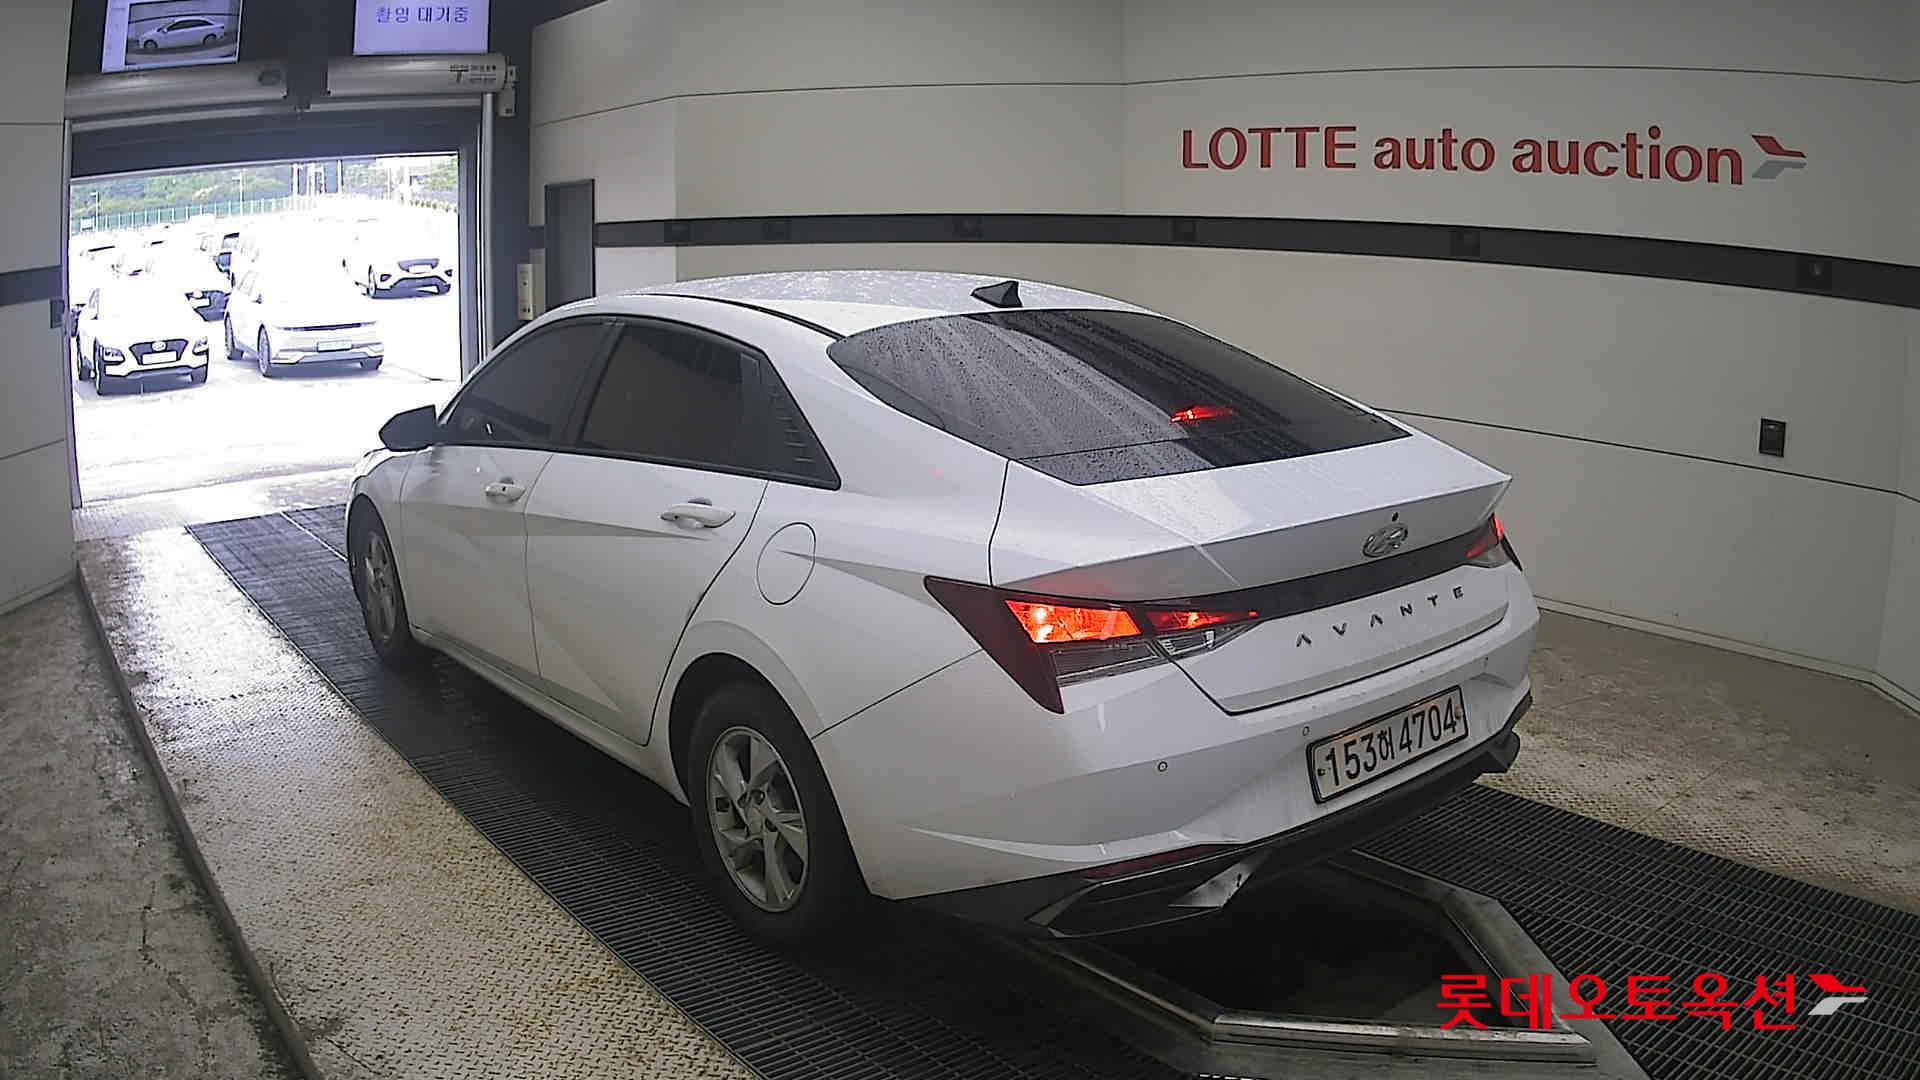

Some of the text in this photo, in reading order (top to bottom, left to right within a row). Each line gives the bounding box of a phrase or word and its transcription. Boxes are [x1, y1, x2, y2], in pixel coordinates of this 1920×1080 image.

[417, 6, 469, 23] 대기중
[1182, 125, 1744, 186] LOTTE auto auction
[1295, 585, 1465, 649] AVANTE
[1325, 697, 1457, 787] 153허4704
